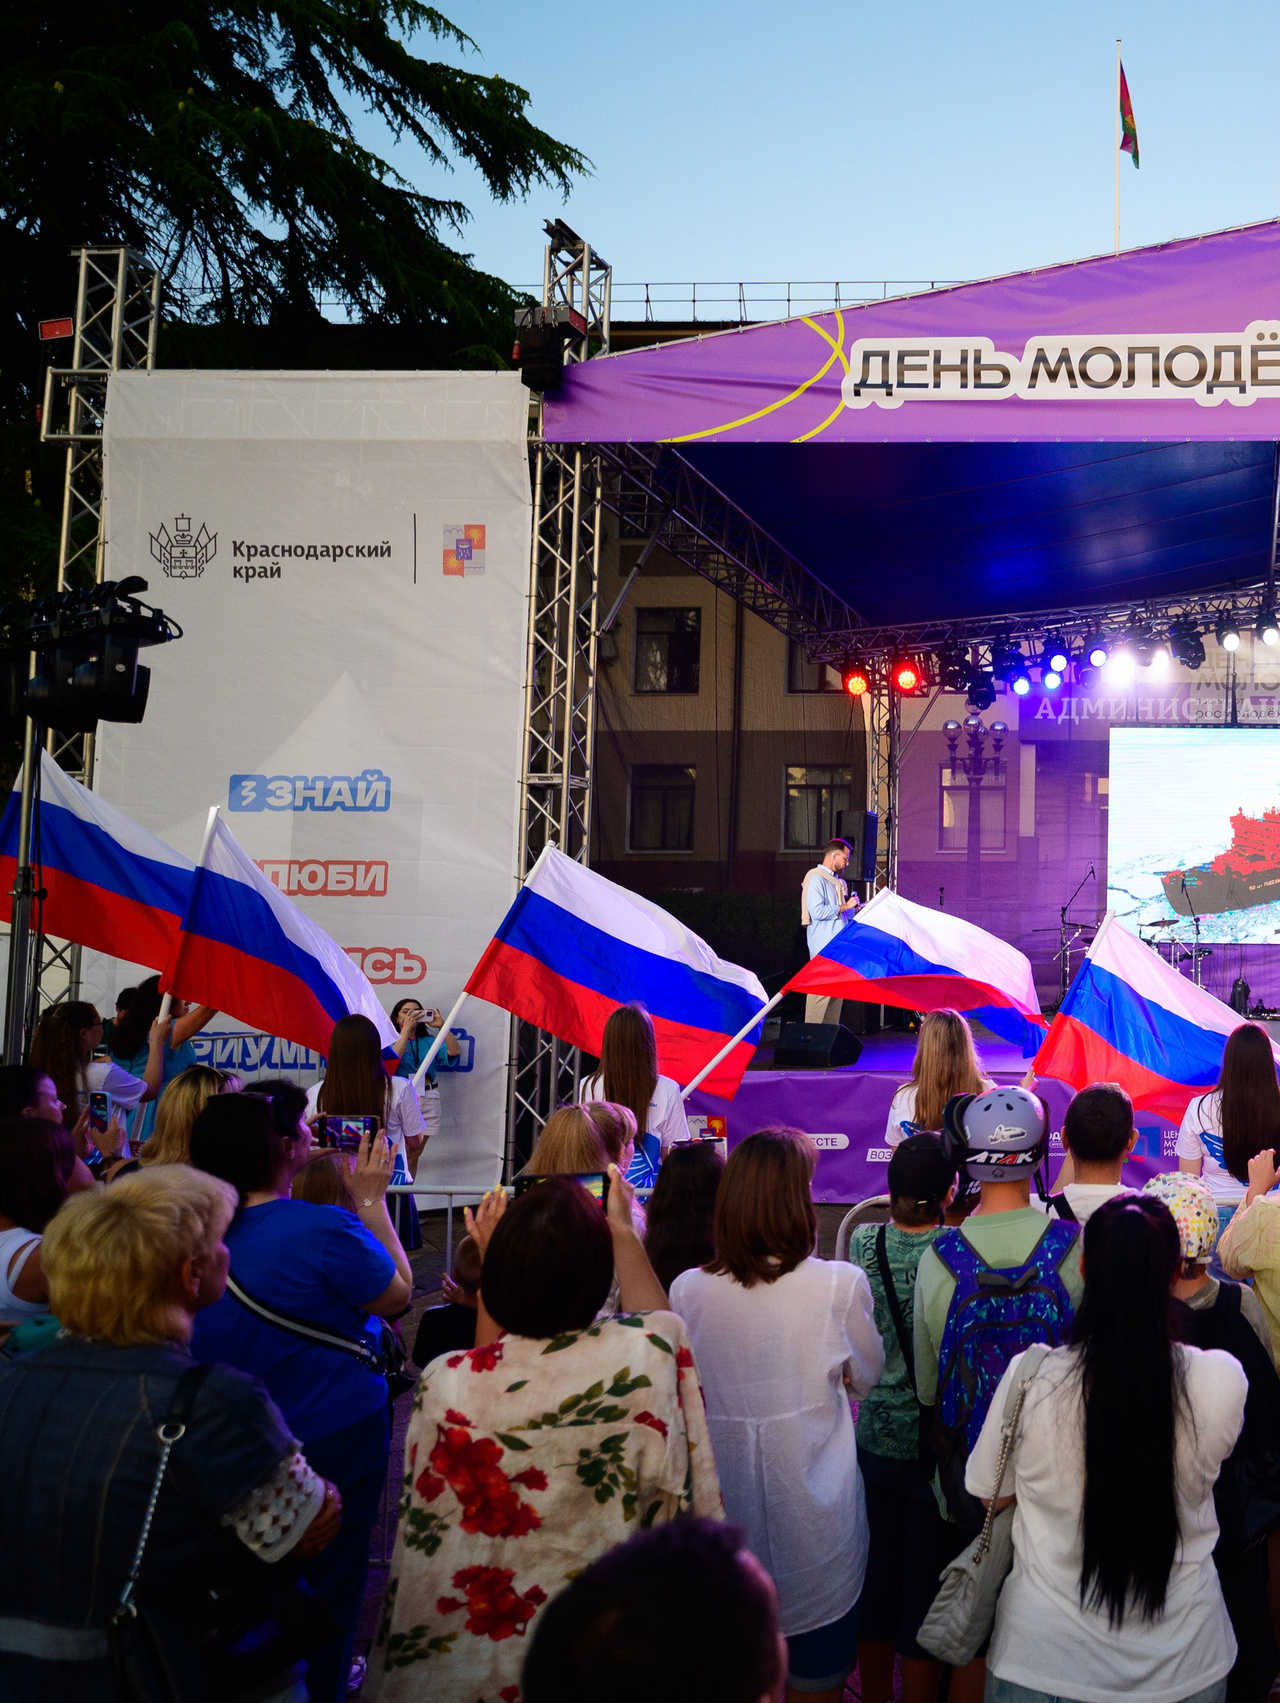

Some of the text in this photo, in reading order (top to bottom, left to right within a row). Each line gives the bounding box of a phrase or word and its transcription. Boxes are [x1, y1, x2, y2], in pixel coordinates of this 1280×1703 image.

[853, 349, 1012, 397] ДЕНЬ
[231, 540, 392, 562] Краснодарский
[232, 562, 282, 583] край
